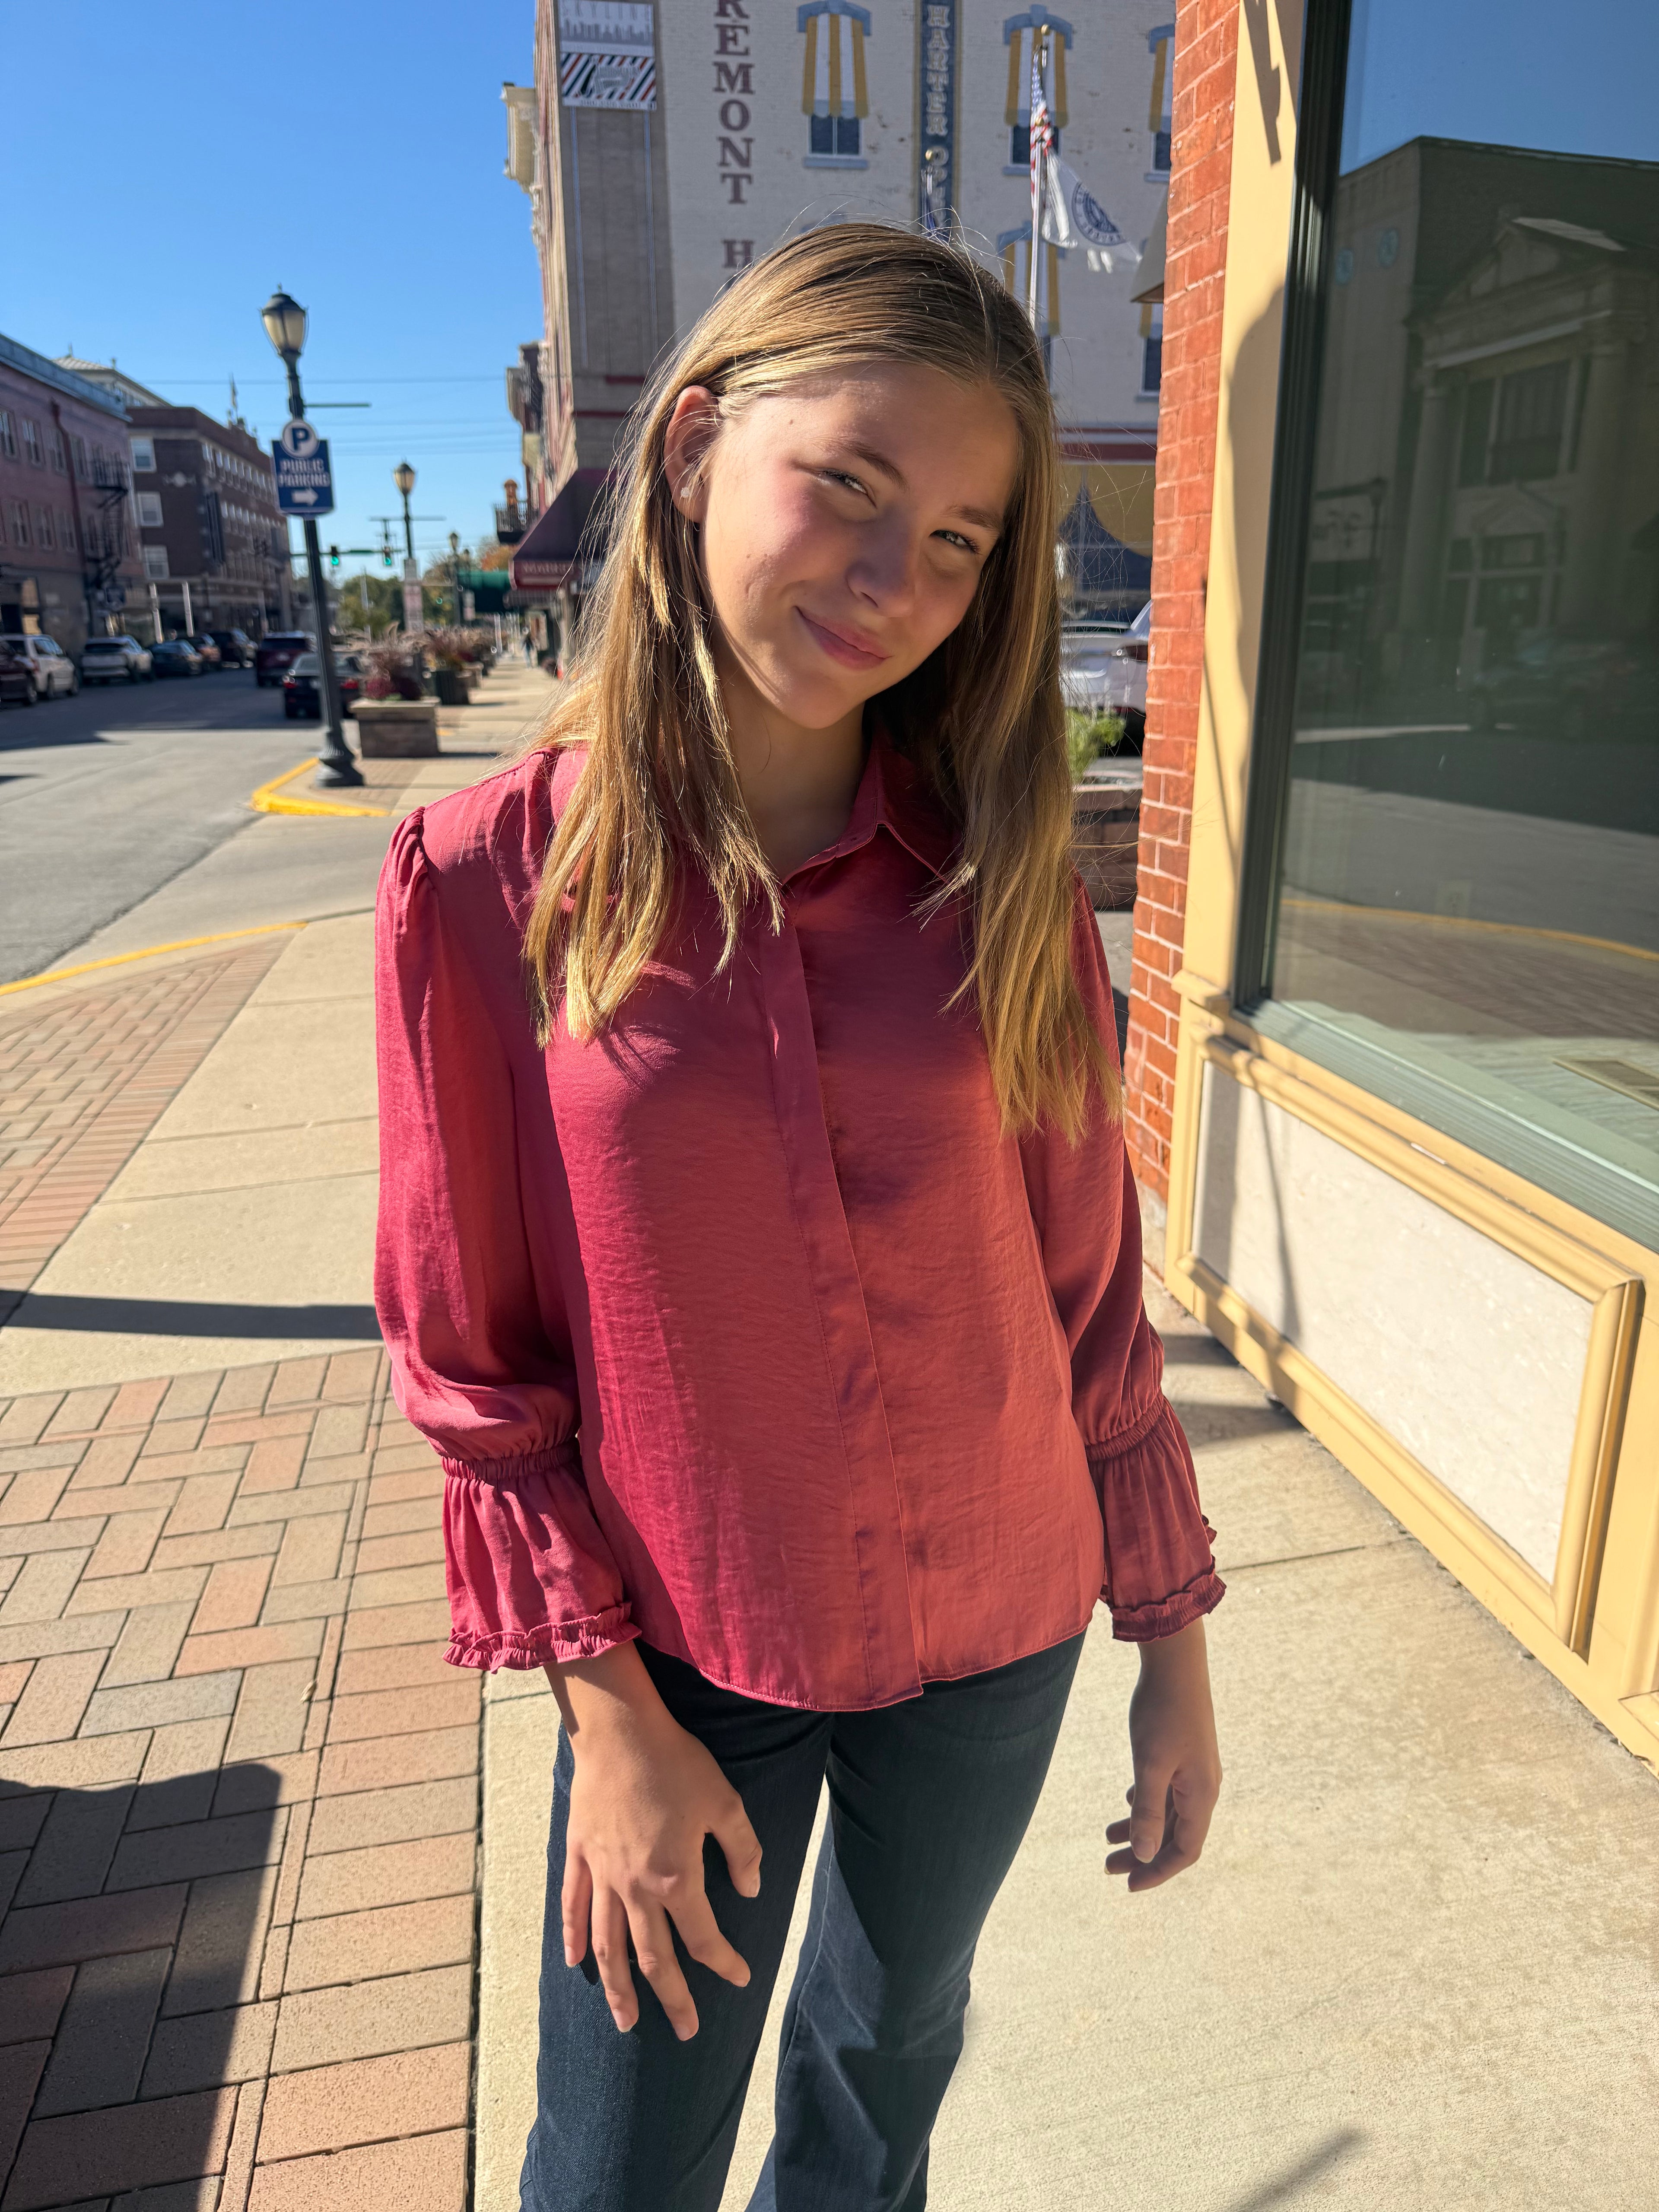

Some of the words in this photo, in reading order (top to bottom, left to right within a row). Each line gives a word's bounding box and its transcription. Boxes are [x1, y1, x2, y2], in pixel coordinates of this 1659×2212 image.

[926, 5, 950, 136] HARTER
[292, 427, 310, 451] P
[280, 459, 324, 473] PUBLIC
[278, 473, 330, 487] PARKING
